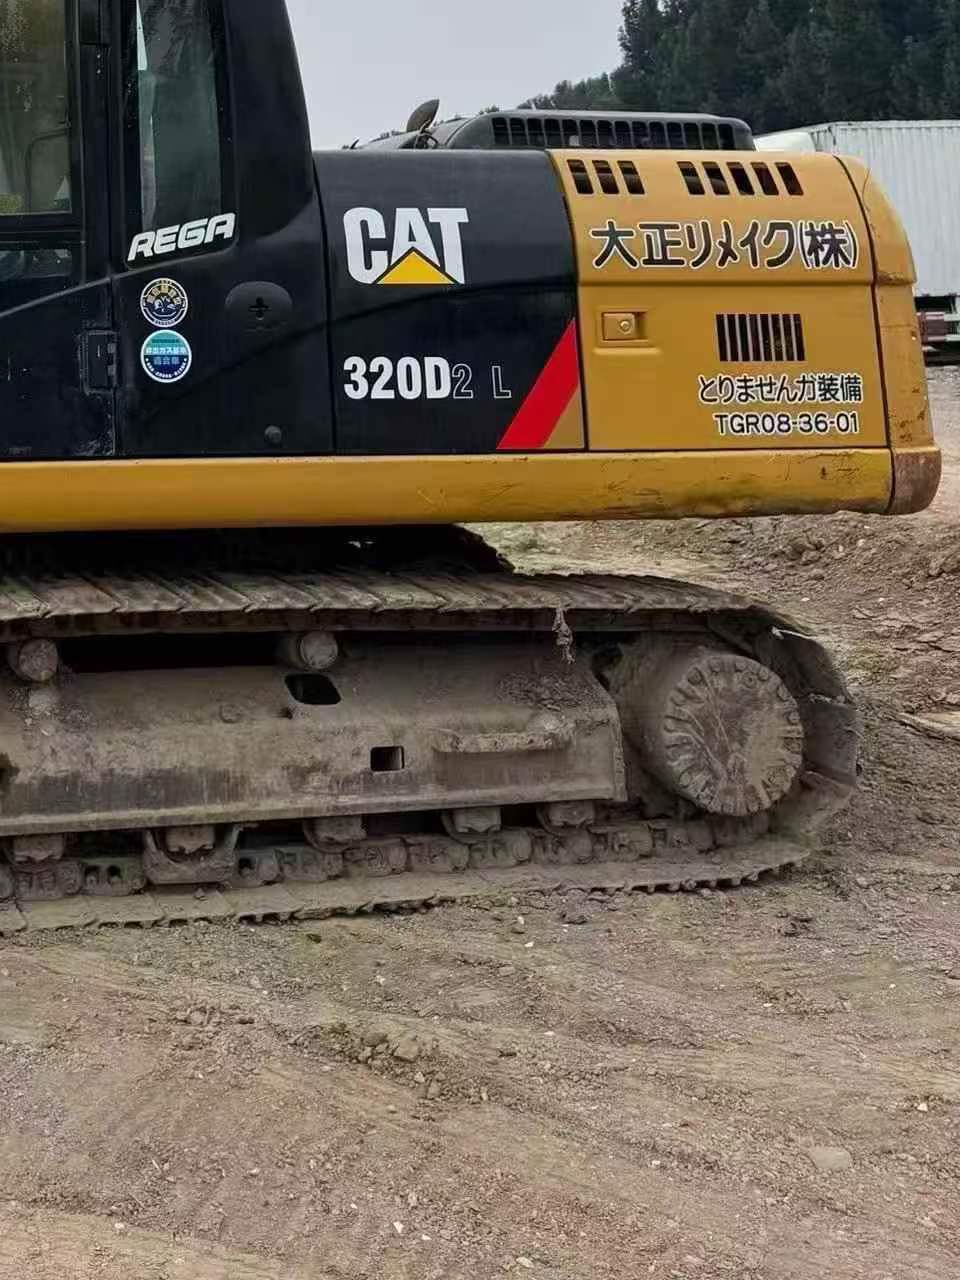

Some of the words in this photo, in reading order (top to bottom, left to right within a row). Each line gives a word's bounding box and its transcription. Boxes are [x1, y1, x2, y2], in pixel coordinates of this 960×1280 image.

[127, 212, 236, 261] REGA
[344, 207, 469, 285] CAT
[590, 220, 857, 269] 大正リメイク(株)
[491, 365, 512, 399] L
[713, 412, 859, 435] TGR08-36-01
